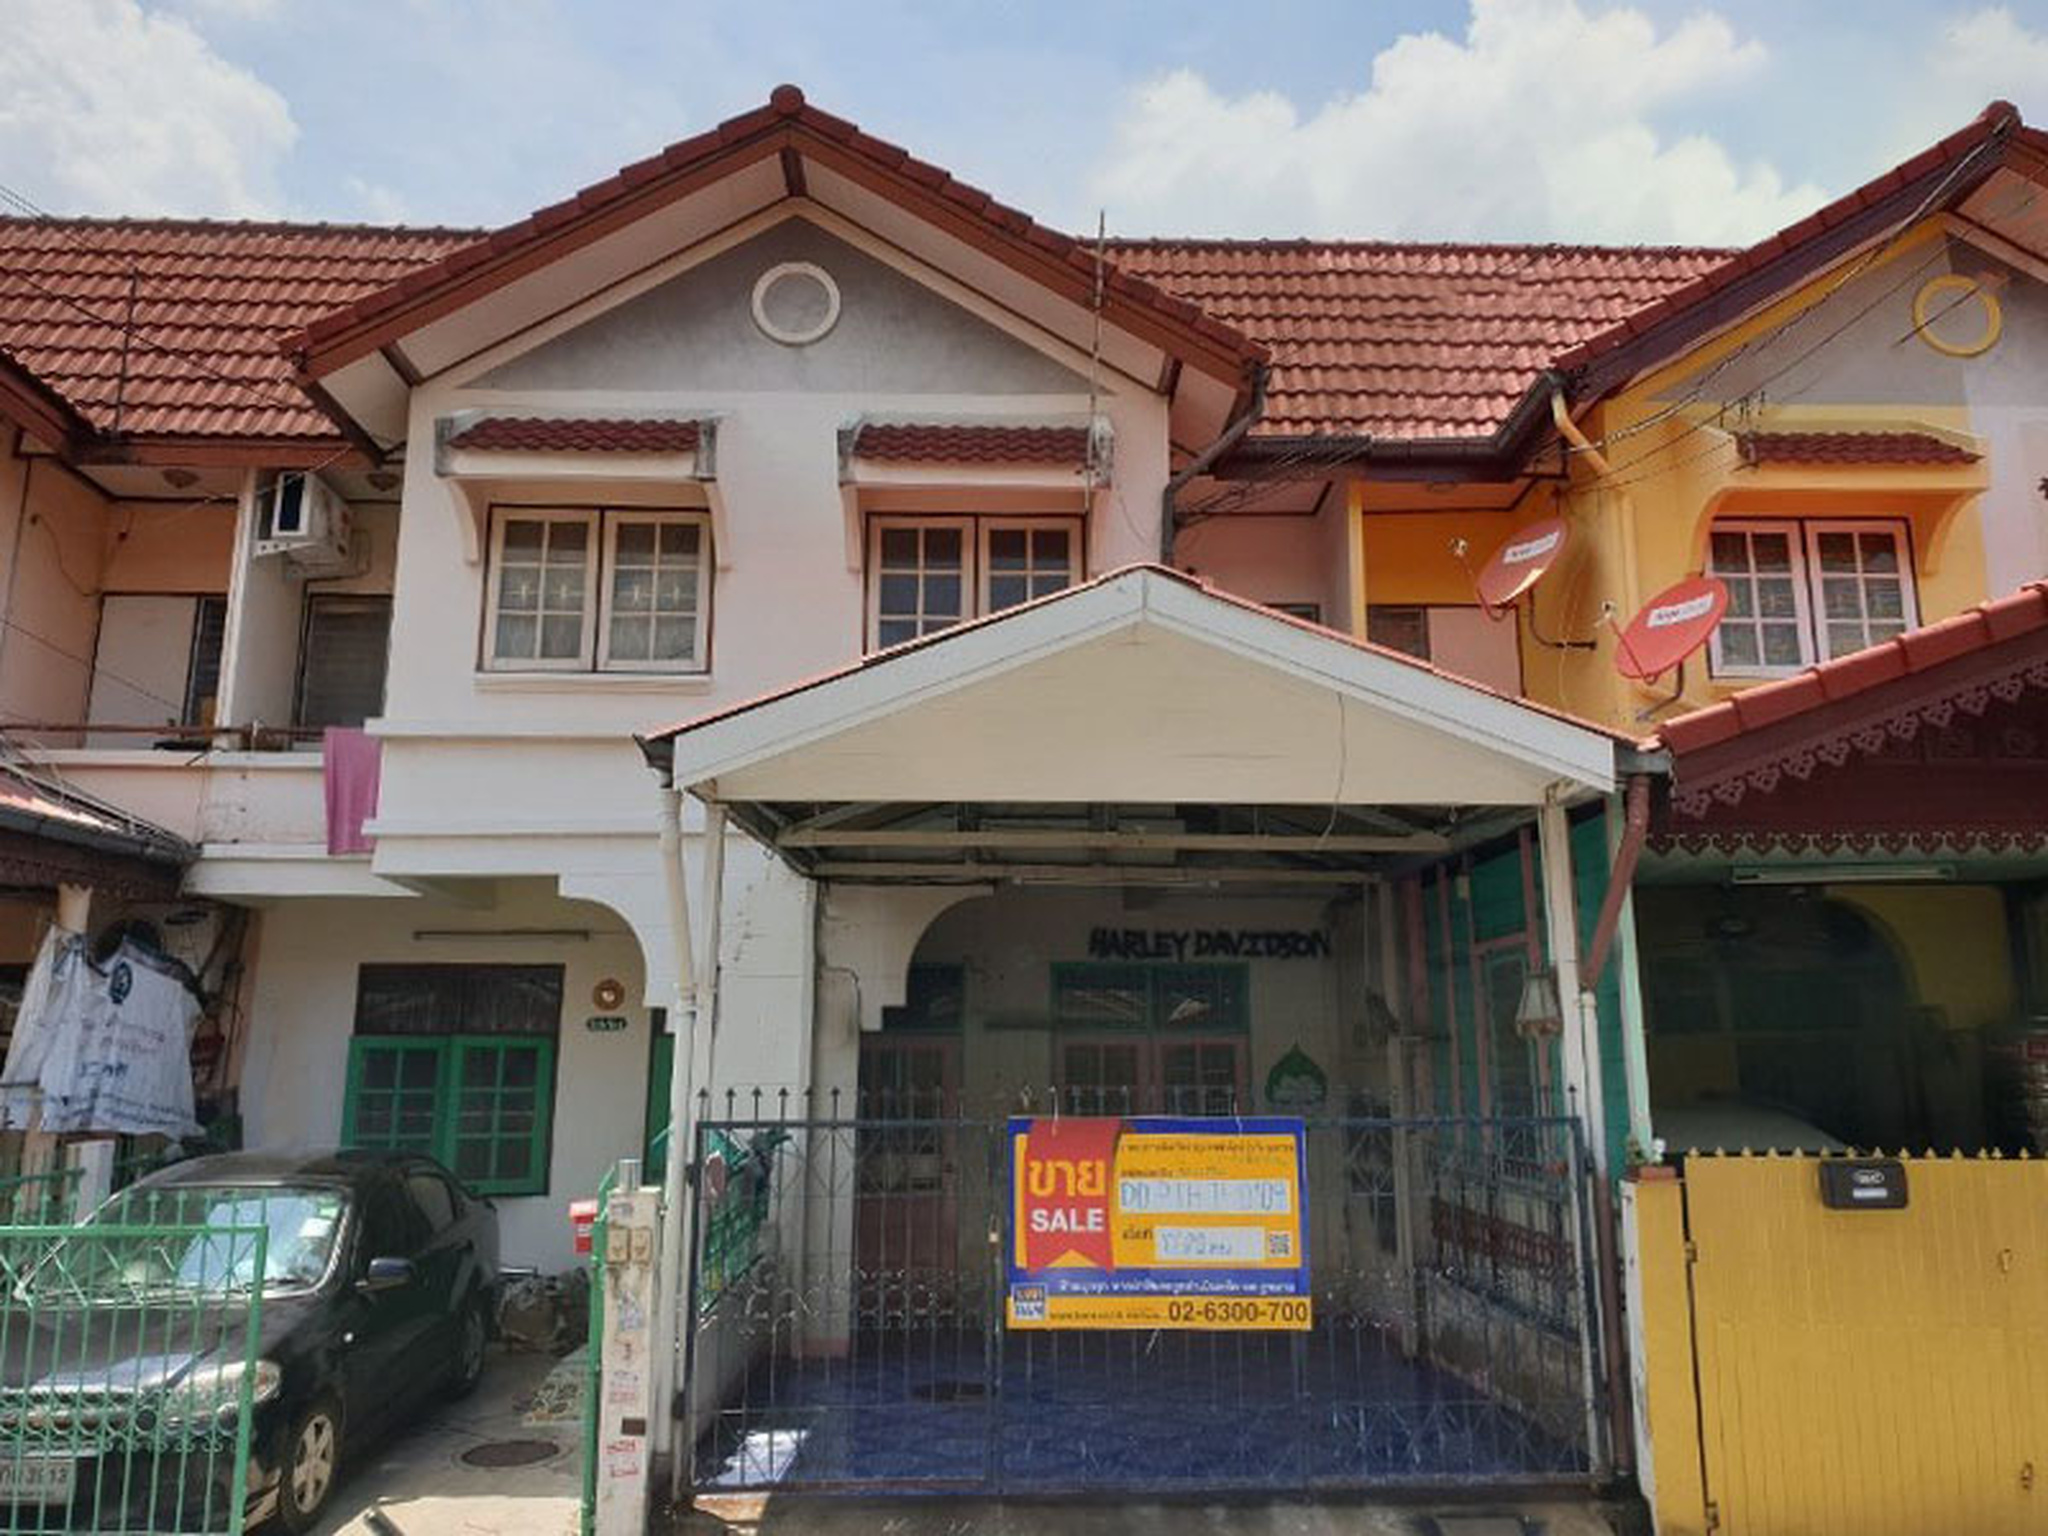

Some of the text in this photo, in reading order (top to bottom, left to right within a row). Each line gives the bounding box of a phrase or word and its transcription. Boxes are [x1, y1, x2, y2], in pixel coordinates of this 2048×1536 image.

[1088, 927, 1331, 962] HARLEY DAVIDSON
[1028, 1160, 1106, 1197] ขาย
[1030, 1208, 1105, 1232] SALE
[1168, 1301, 1308, 1323] 02-6300-700
